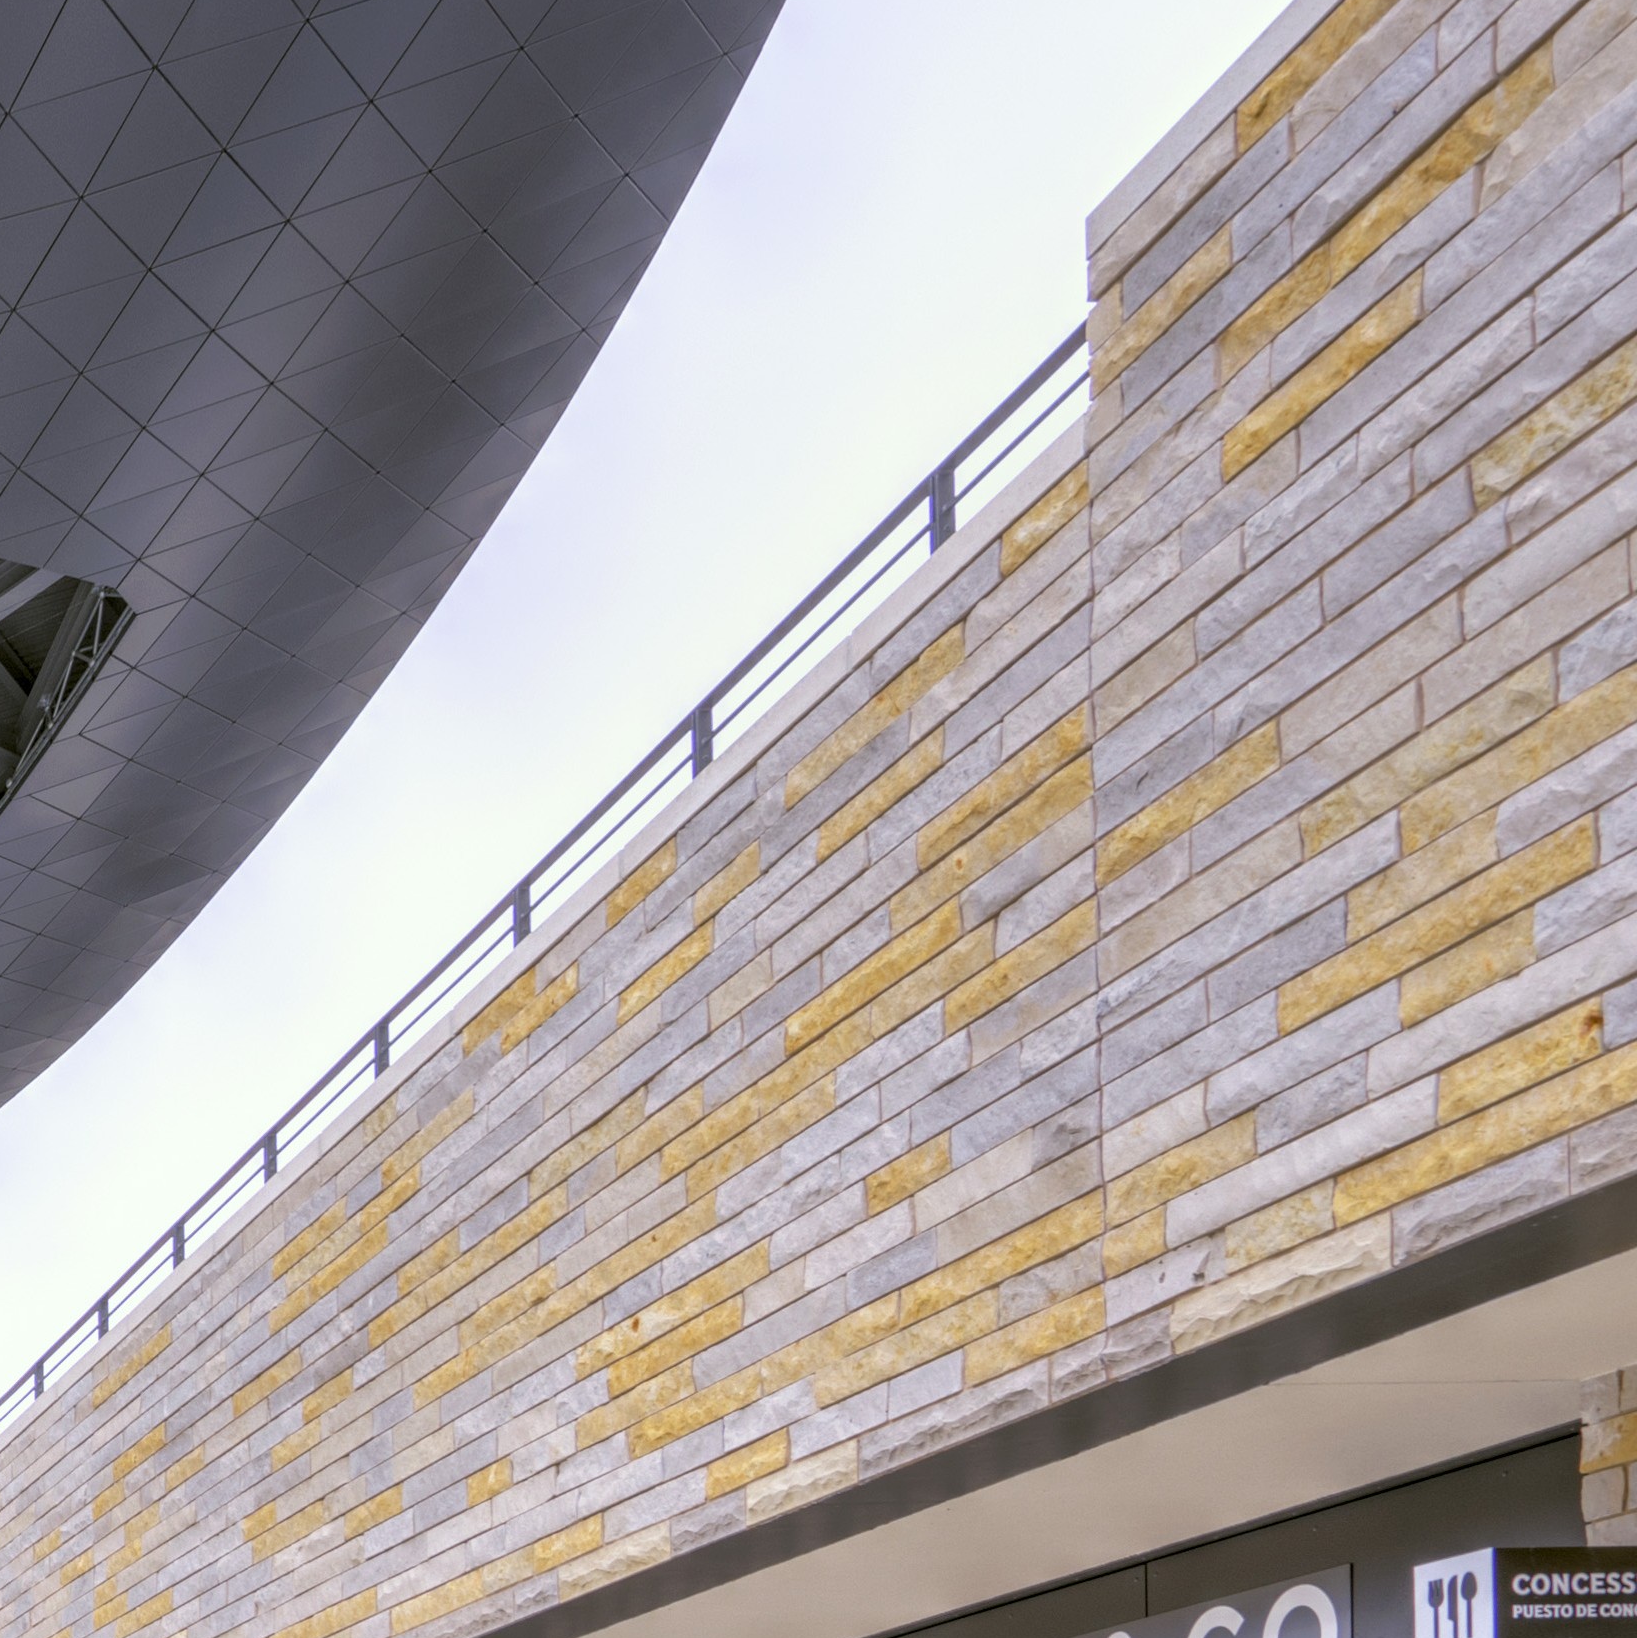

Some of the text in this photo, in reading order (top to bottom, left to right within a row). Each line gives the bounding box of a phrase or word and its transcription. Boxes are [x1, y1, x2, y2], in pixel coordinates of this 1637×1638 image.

[1512, 1571, 1637, 1596] CONCESS
[1512, 1604, 1574, 1619] PUESTO
[1575, 1603, 1598, 1618] DE
